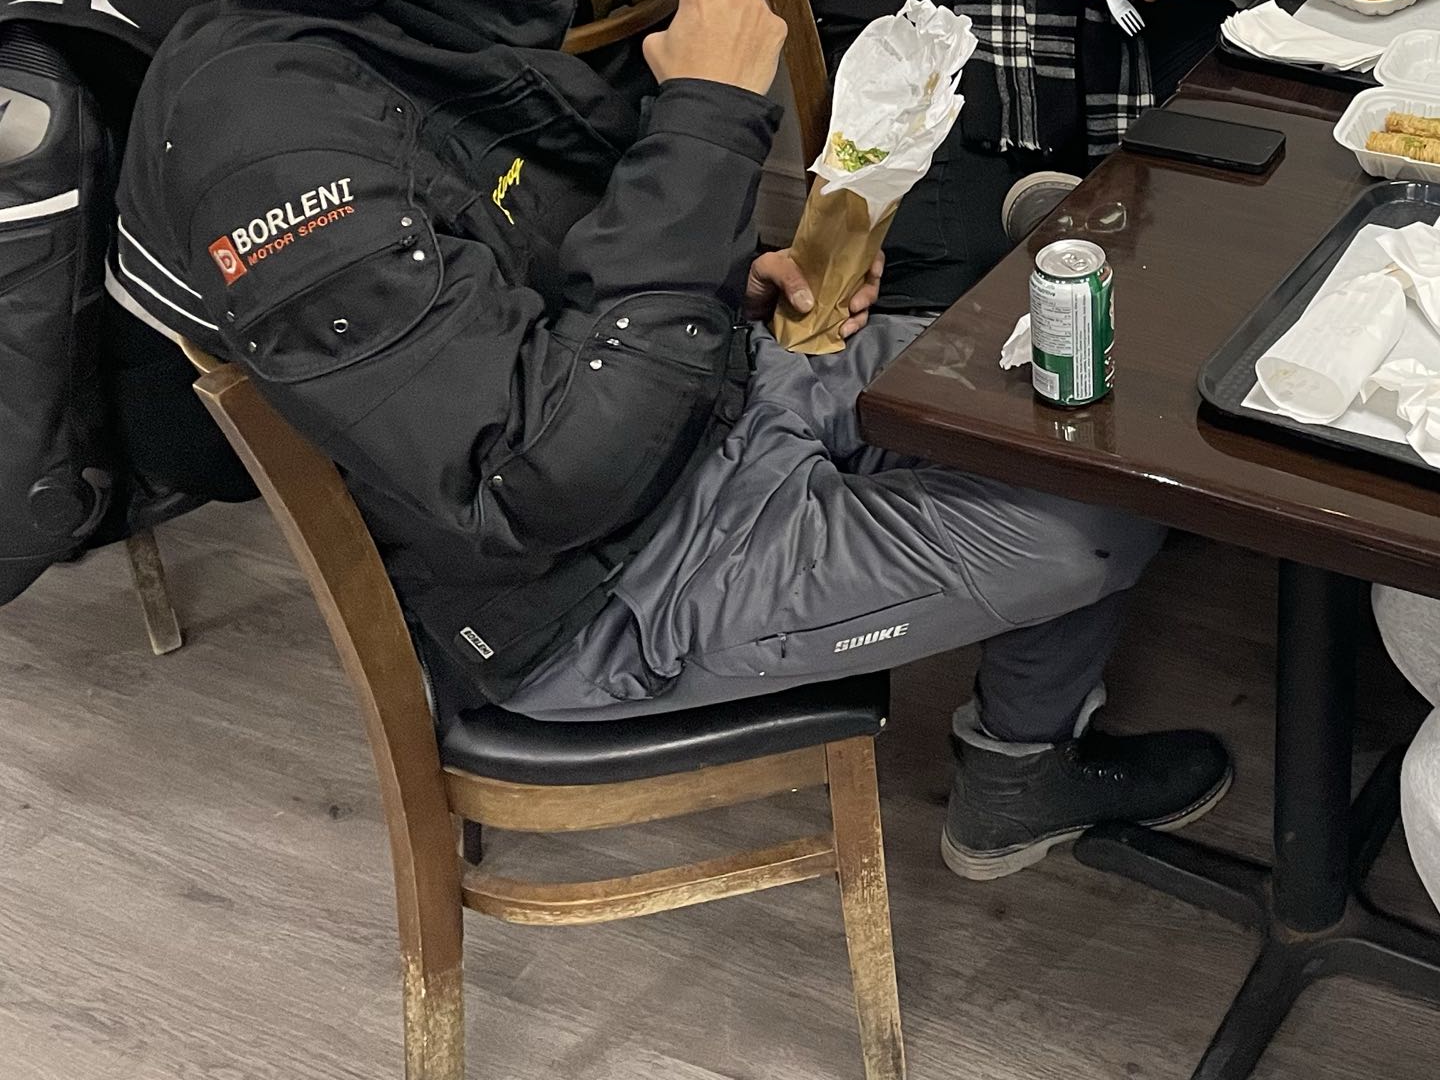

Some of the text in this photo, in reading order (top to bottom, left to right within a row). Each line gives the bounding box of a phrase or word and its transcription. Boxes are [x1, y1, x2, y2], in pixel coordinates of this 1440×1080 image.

[231, 177, 354, 255] BORLENI
[247, 205, 355, 266] MOTOR SPORTS
[833, 622, 911, 653] SOUKE
